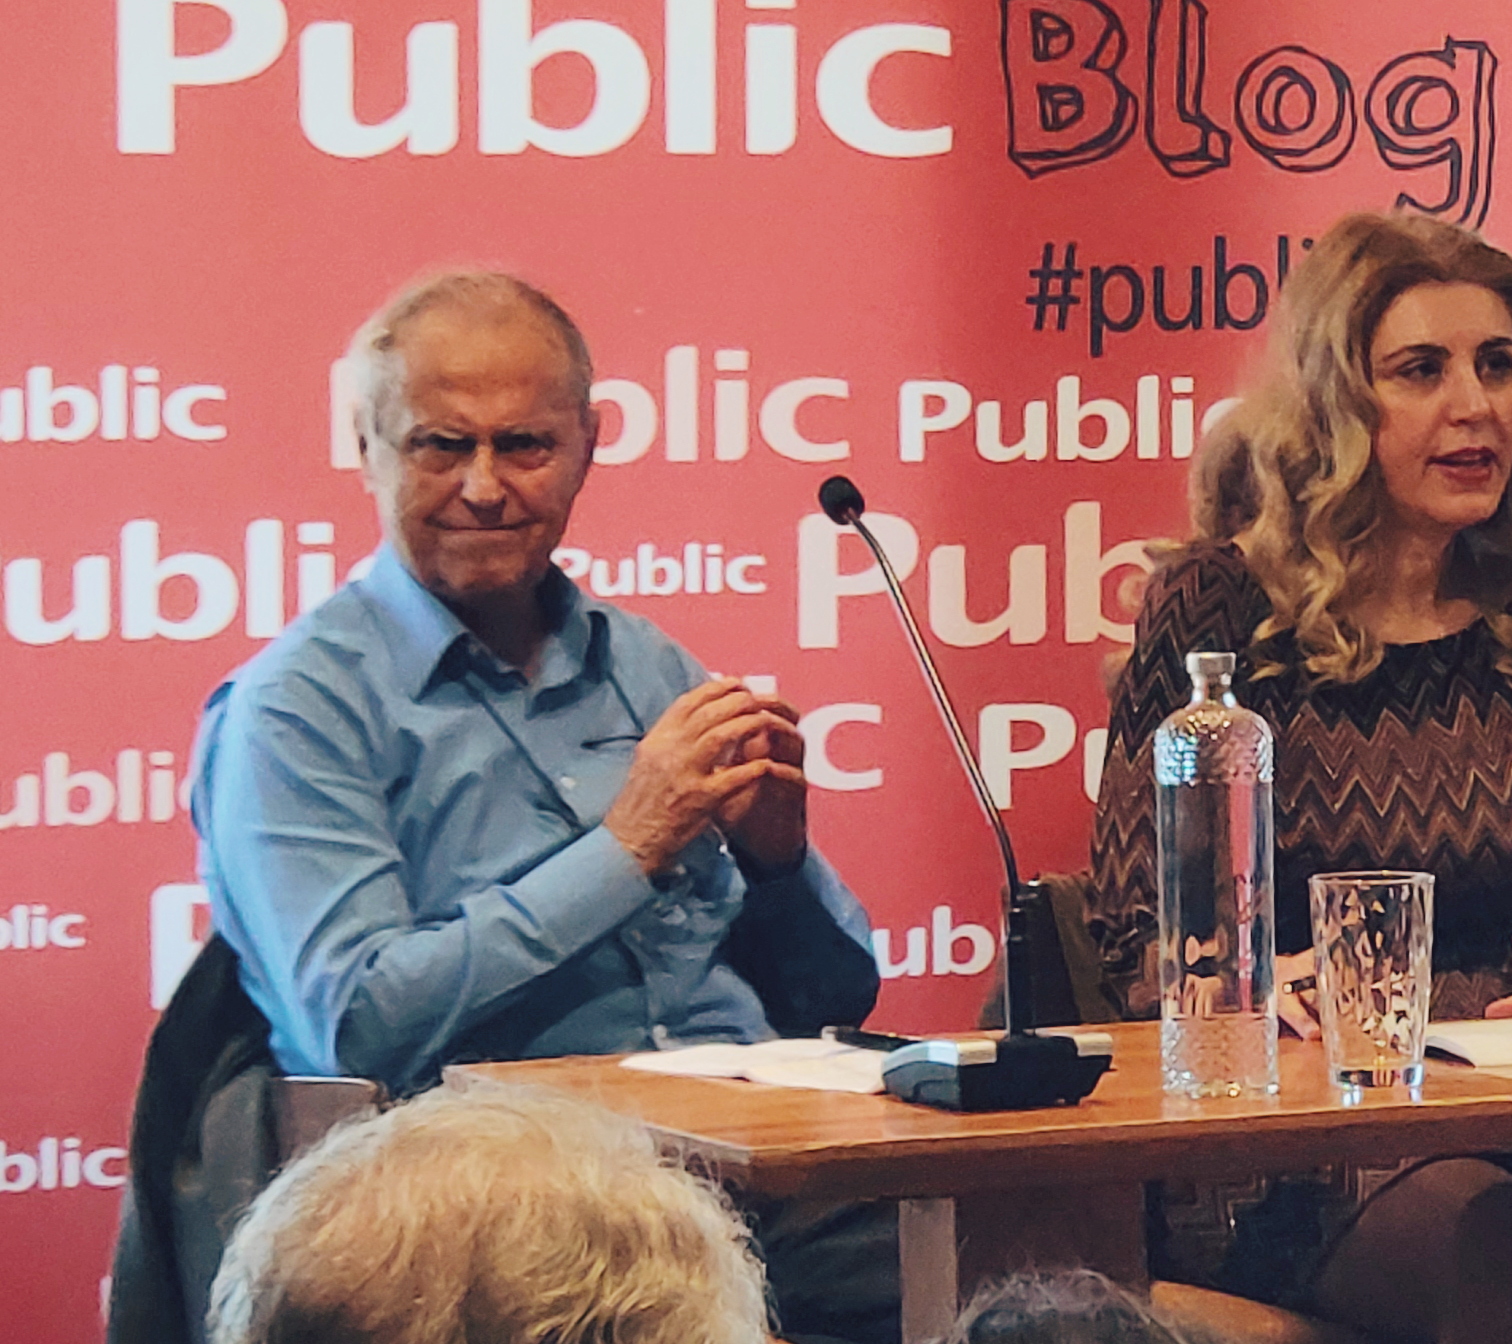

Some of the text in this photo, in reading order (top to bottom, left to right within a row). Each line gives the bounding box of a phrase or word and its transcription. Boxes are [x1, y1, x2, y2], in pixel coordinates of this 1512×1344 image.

[0, 363, 228, 444] blic
[898, 374, 1243, 463] Publi
[3, 518, 375, 645] ubli
[797, 501, 1160, 648] Pub
